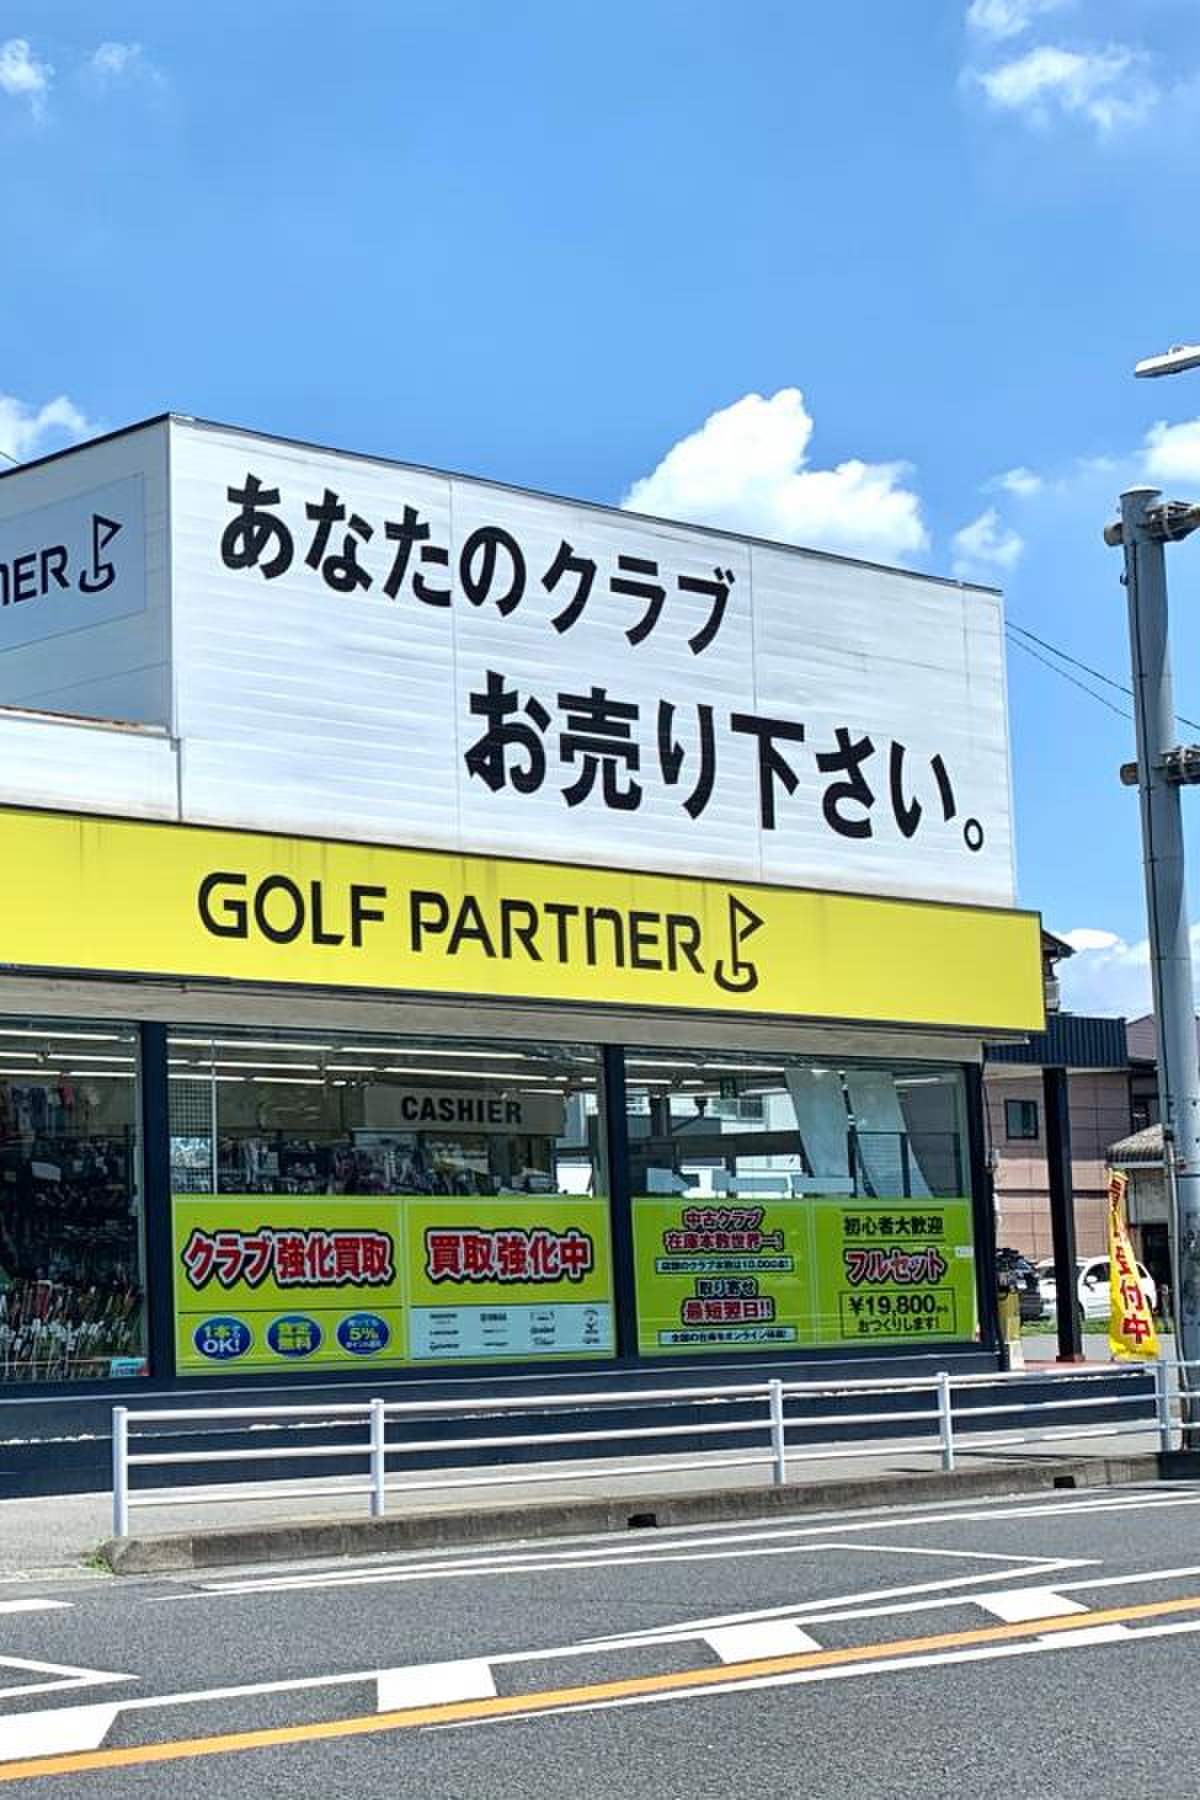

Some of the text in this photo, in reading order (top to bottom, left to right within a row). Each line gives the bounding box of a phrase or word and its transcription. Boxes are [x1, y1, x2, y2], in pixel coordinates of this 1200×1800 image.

[221, 473, 736, 656] あなたのクラブ
[463, 669, 984, 852] お売り下さい。
[198, 872, 705, 974] GOLF PARTNER
[400, 1095, 523, 1125] CASHIER
[684, 1208, 763, 1229] 中古クラブ
[845, 1216, 944, 1234] 初心者大歓迎
[184, 1229, 394, 1287] クラブ強化買取
[425, 1229, 594, 1284] 買取強化中
[845, 1249, 946, 1285] フルセット
[202, 1339, 240, 1353] OK!
[349, 1327, 379, 1340] 5%
